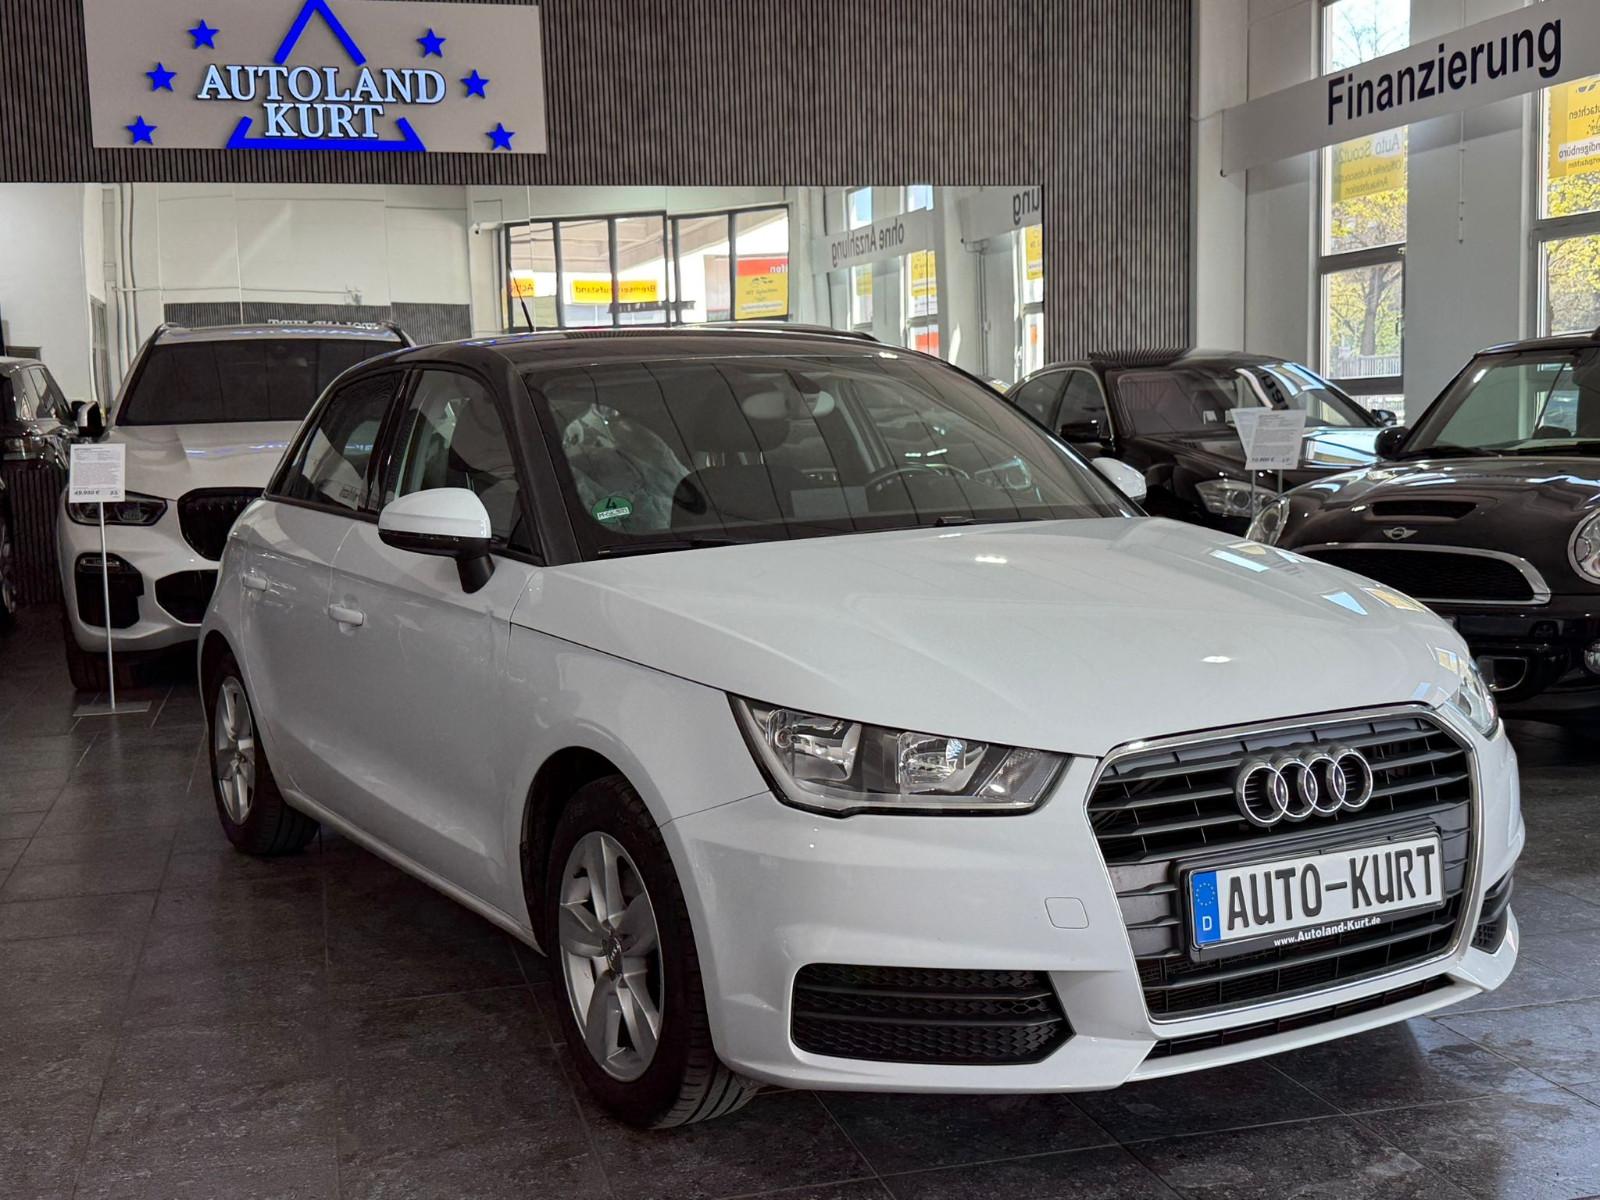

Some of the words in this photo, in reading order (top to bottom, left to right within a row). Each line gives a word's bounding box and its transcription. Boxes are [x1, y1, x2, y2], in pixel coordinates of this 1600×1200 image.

[196, 63, 447, 105] AUTOLAND
[1327, 18, 1562, 126] Finanzierung
[262, 102, 384, 139] KURT
[605, 497, 617, 509] 4
[1227, 844, 1436, 931] AUTO-KURT
[1202, 915, 1213, 932] D
[1273, 915, 1382, 947] www.Autoland-Kurt.de
